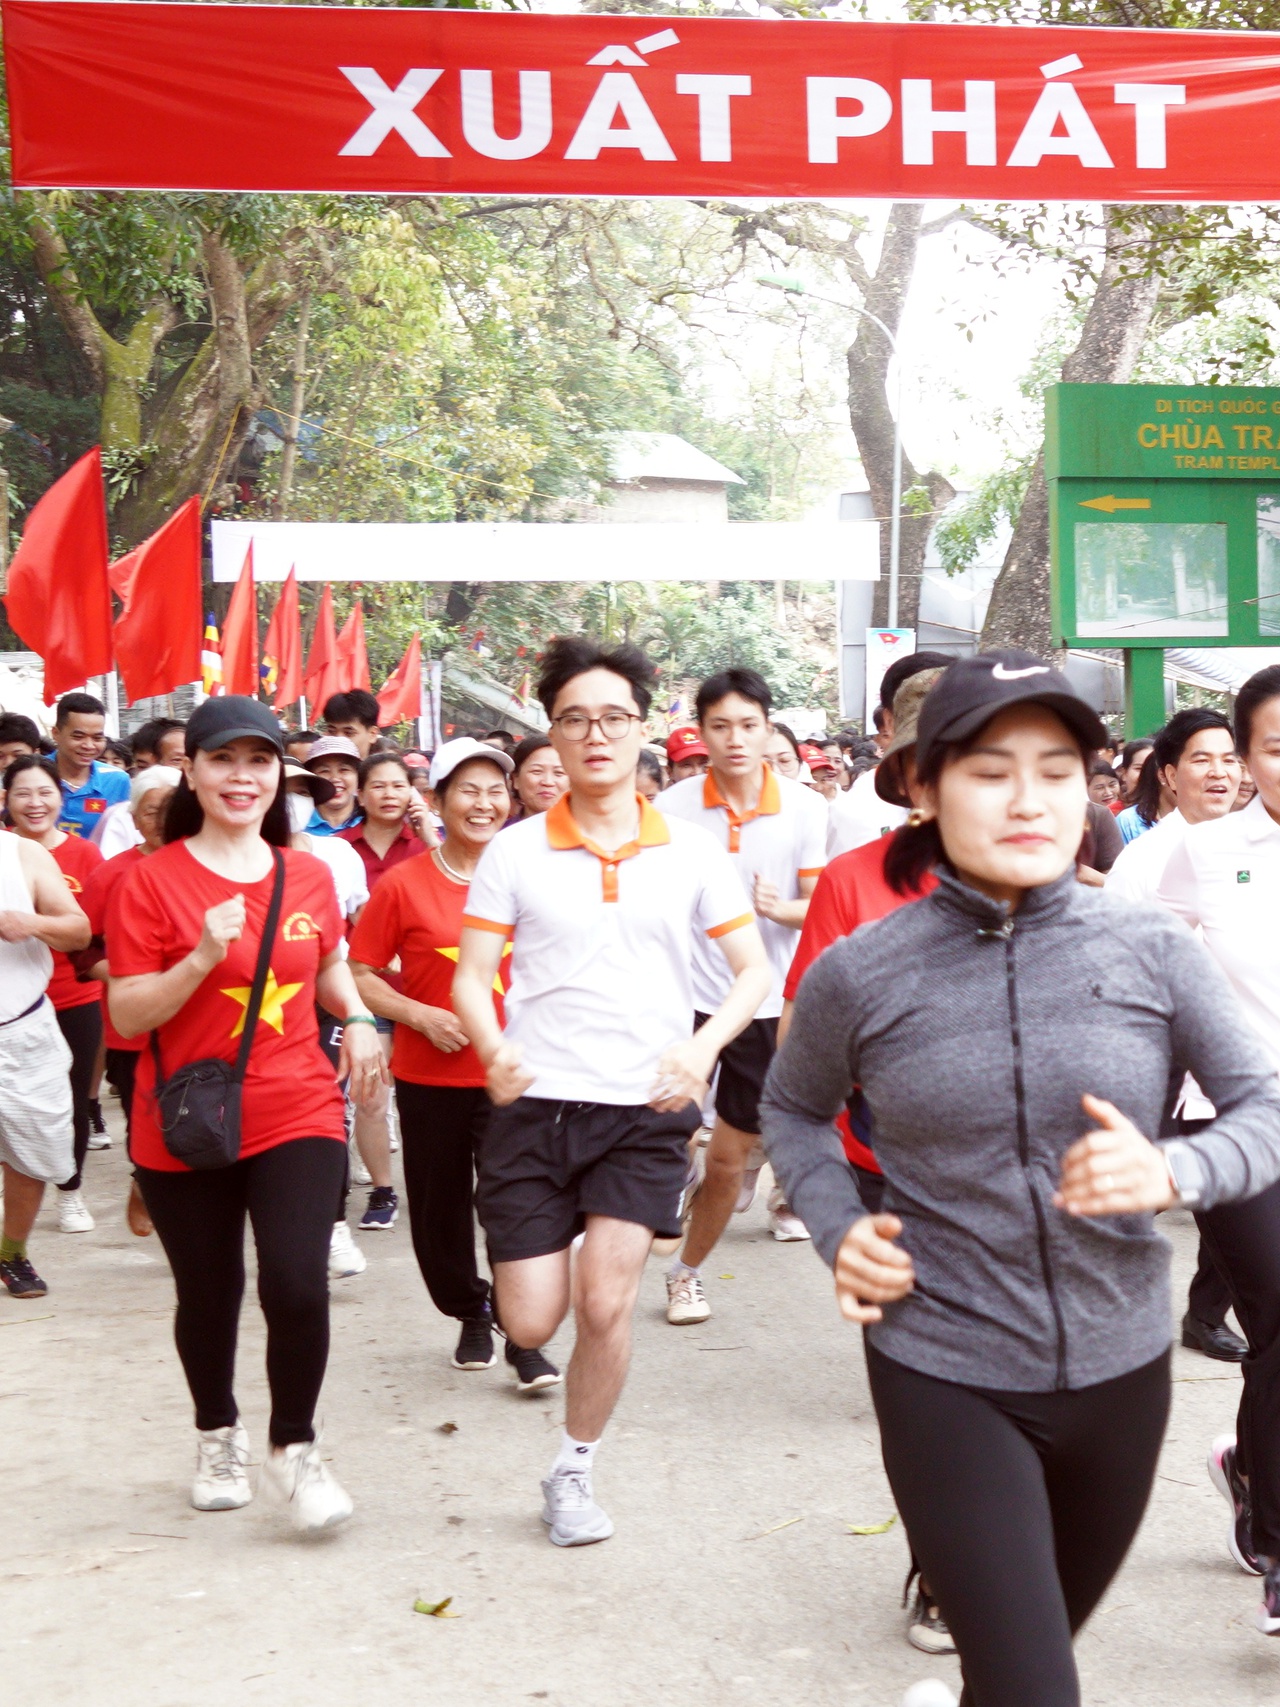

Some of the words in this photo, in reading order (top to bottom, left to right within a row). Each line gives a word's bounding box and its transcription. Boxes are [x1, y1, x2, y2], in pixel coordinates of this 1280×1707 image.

[337, 28, 752, 162] XUẤT
[806, 53, 1187, 169] PHÁT
[1155, 399, 1173, 413] DI
[1177, 398, 1214, 414] TÍCH
[1218, 396, 1267, 415] QUỐC
[1137, 418, 1225, 449] CHÙA
[1173, 455, 1224, 470] TRAM
